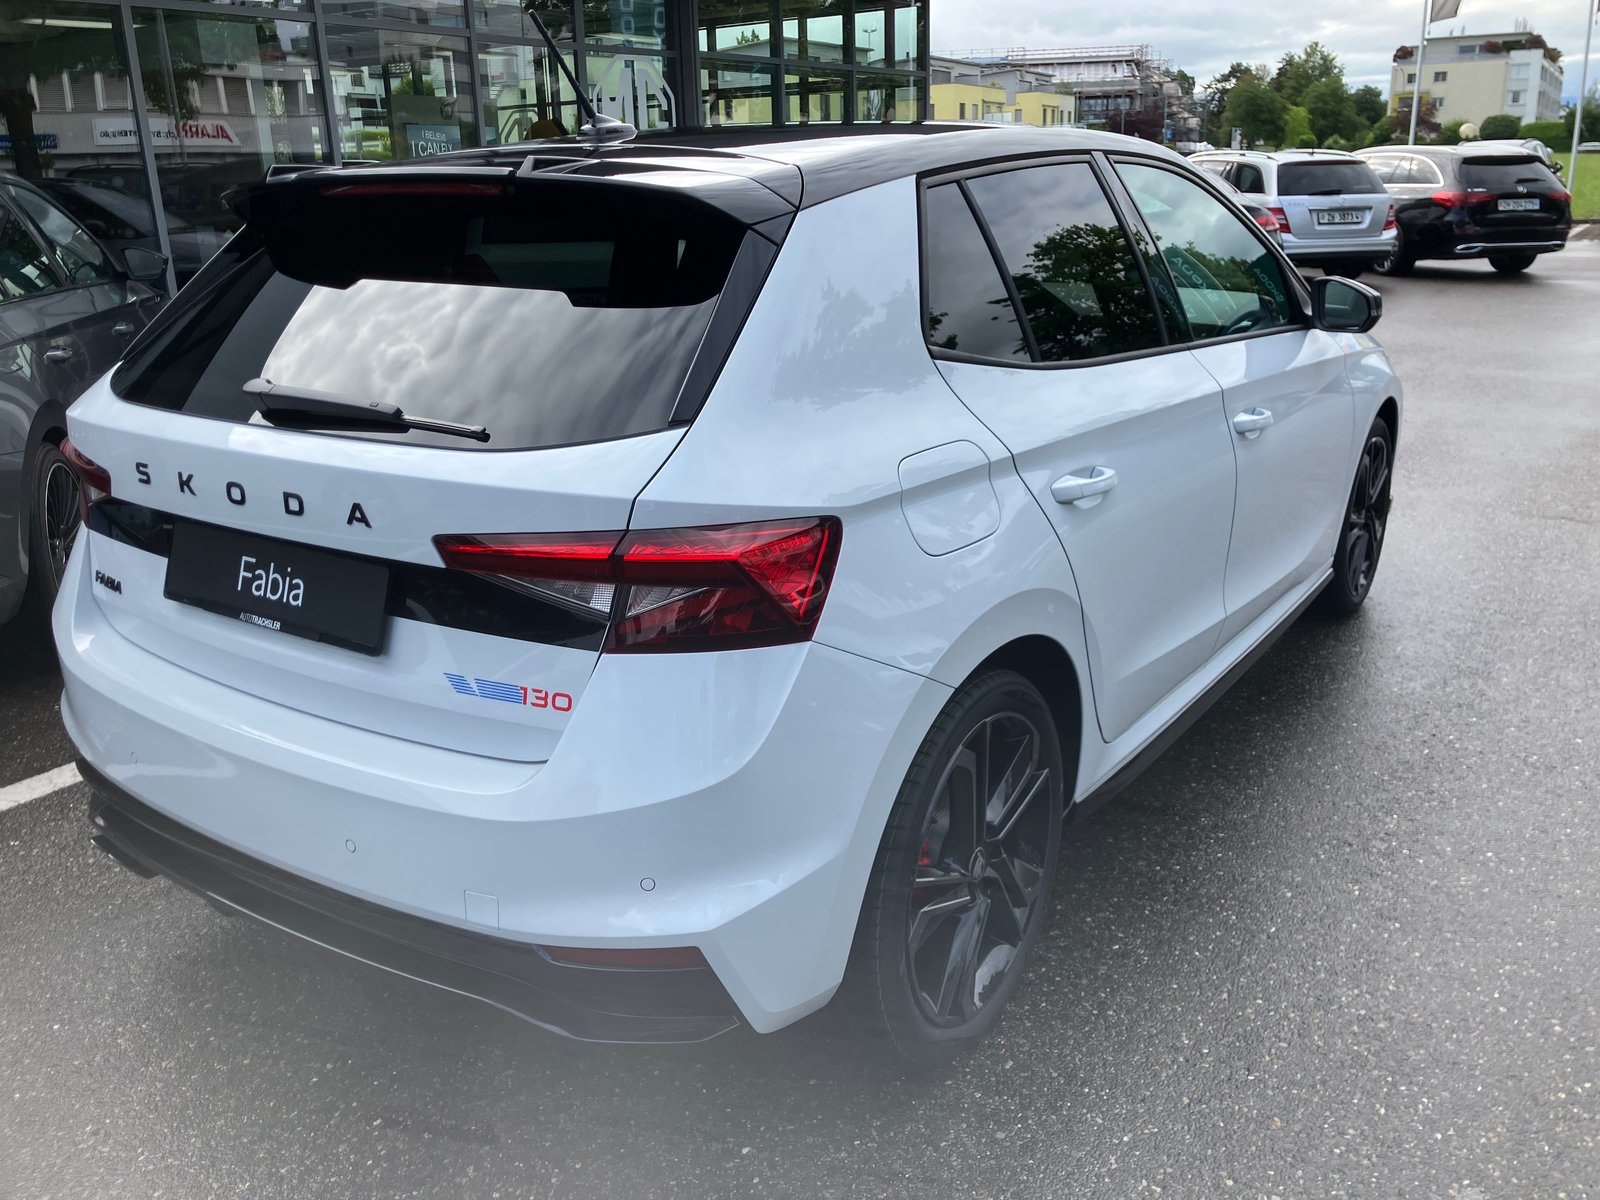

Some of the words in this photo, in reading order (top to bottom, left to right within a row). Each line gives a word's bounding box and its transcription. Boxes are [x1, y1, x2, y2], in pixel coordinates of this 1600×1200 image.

[418, 141, 440, 157] CAN
[94, 569, 123, 595] FABIA
[237, 555, 304, 607] Fabia
[519, 686, 573, 713] 130
